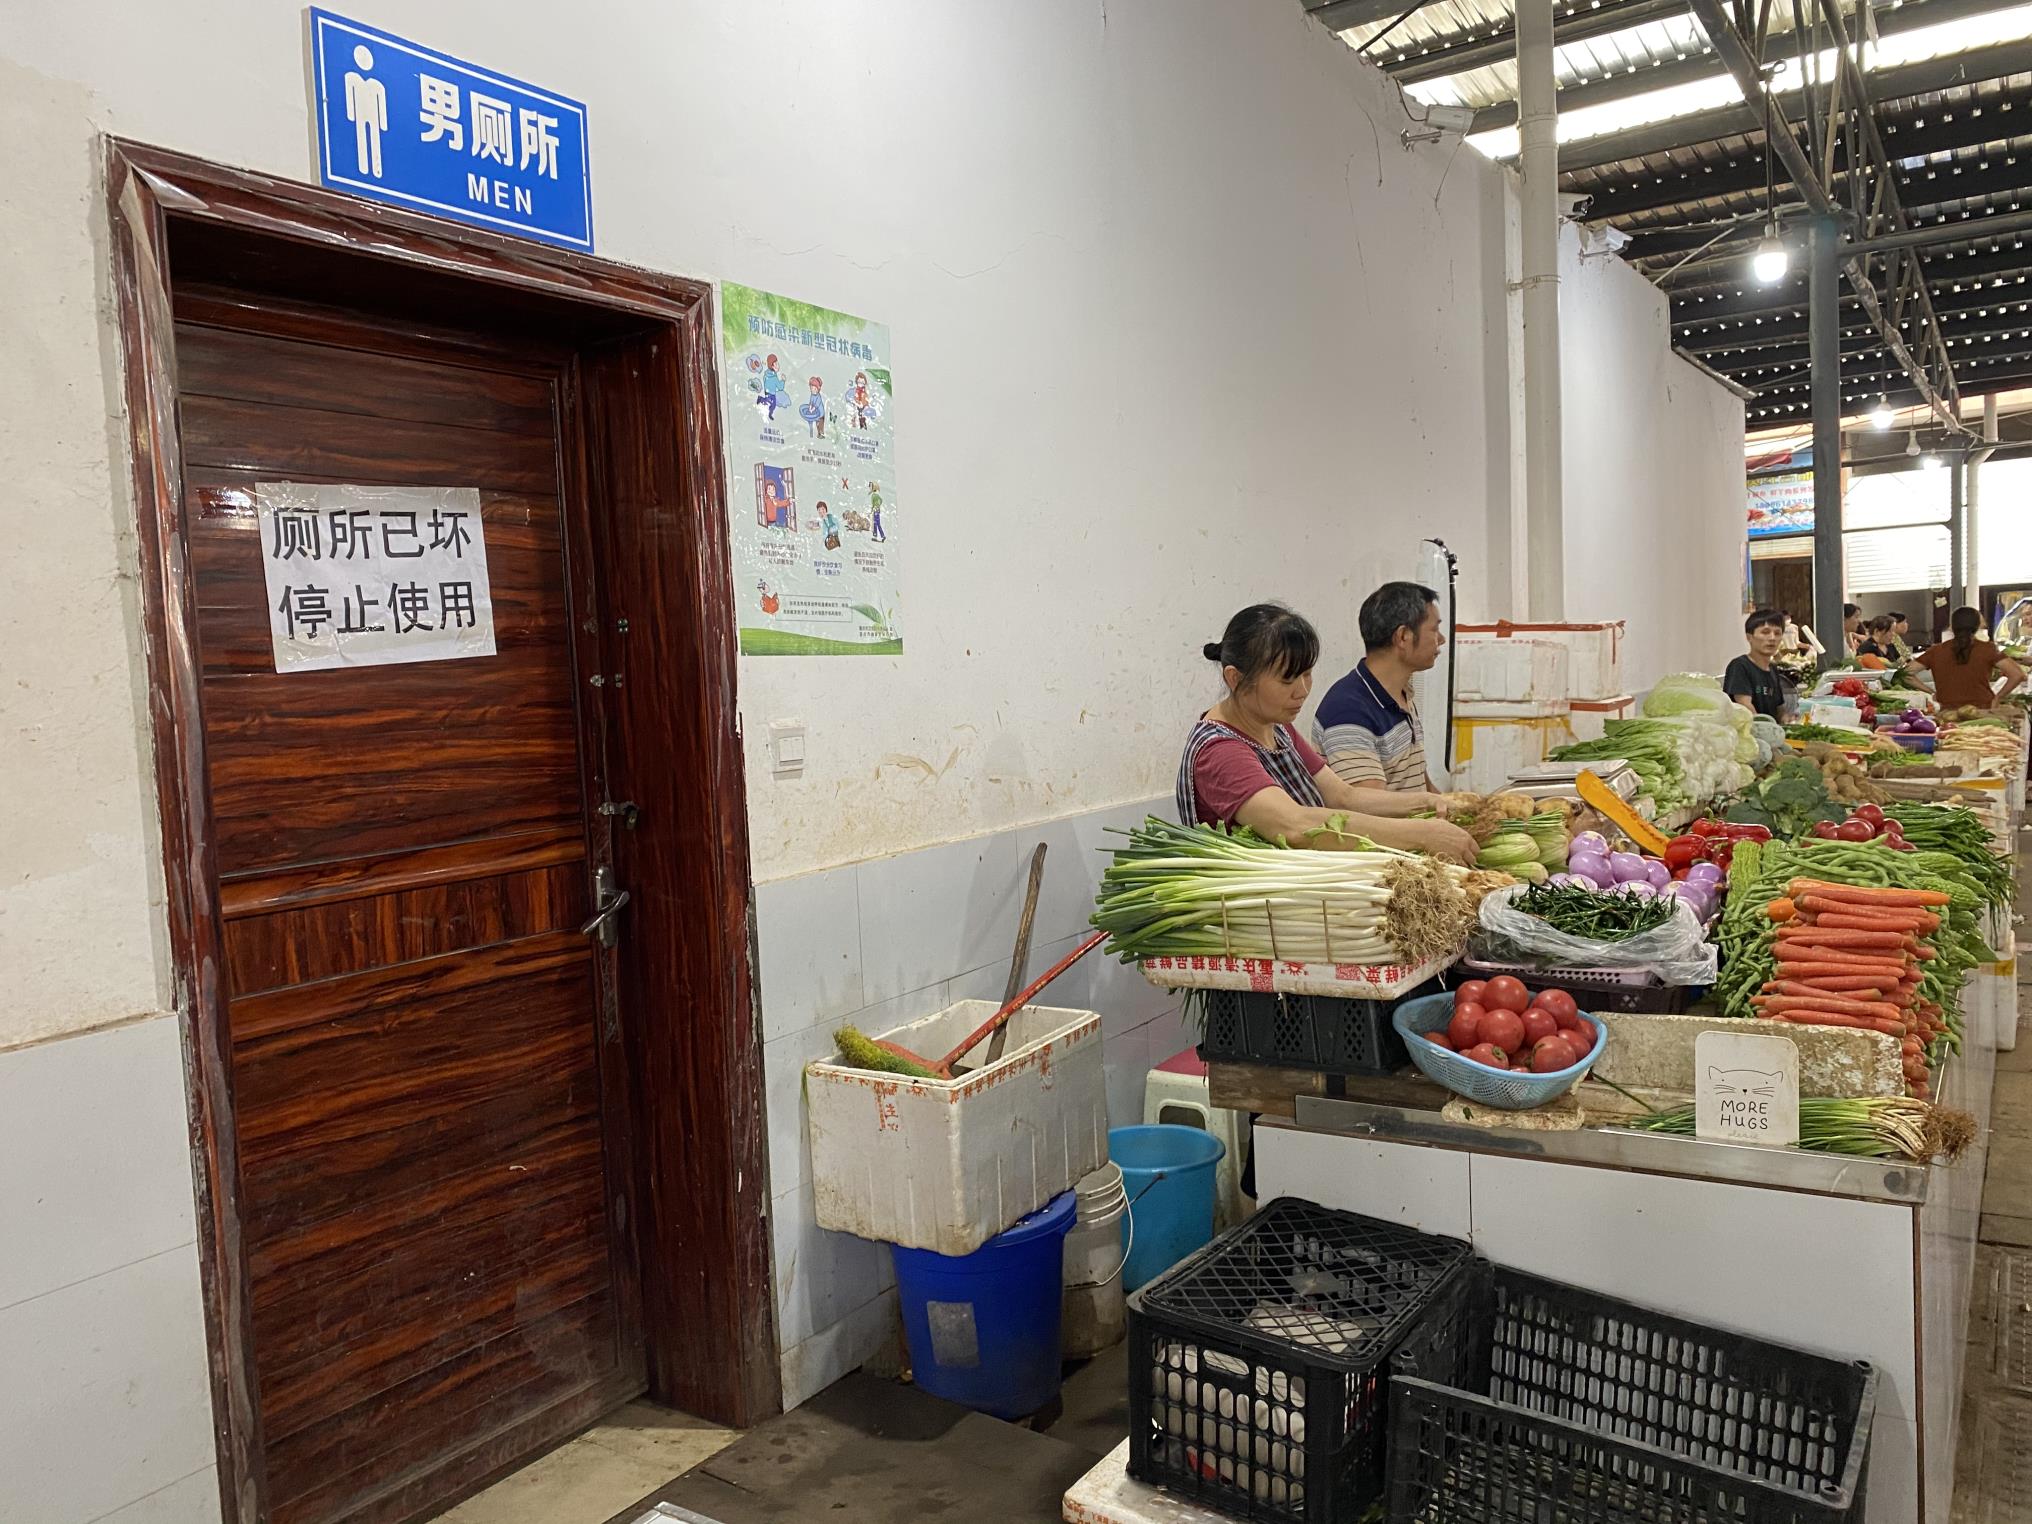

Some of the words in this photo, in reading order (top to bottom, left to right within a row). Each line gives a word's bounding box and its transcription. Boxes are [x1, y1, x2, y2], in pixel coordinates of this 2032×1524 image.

[419, 73, 560, 180] 男厕所
[467, 172, 533, 215] MEN
[748, 315, 873, 362] 预防感染新型冠状病毒
[273, 508, 471, 560] 厕所已坏
[278, 581, 477, 640] 停止使用
[1720, 1100, 1769, 1115] MORE
[1720, 1113, 1769, 1130] HUGS
